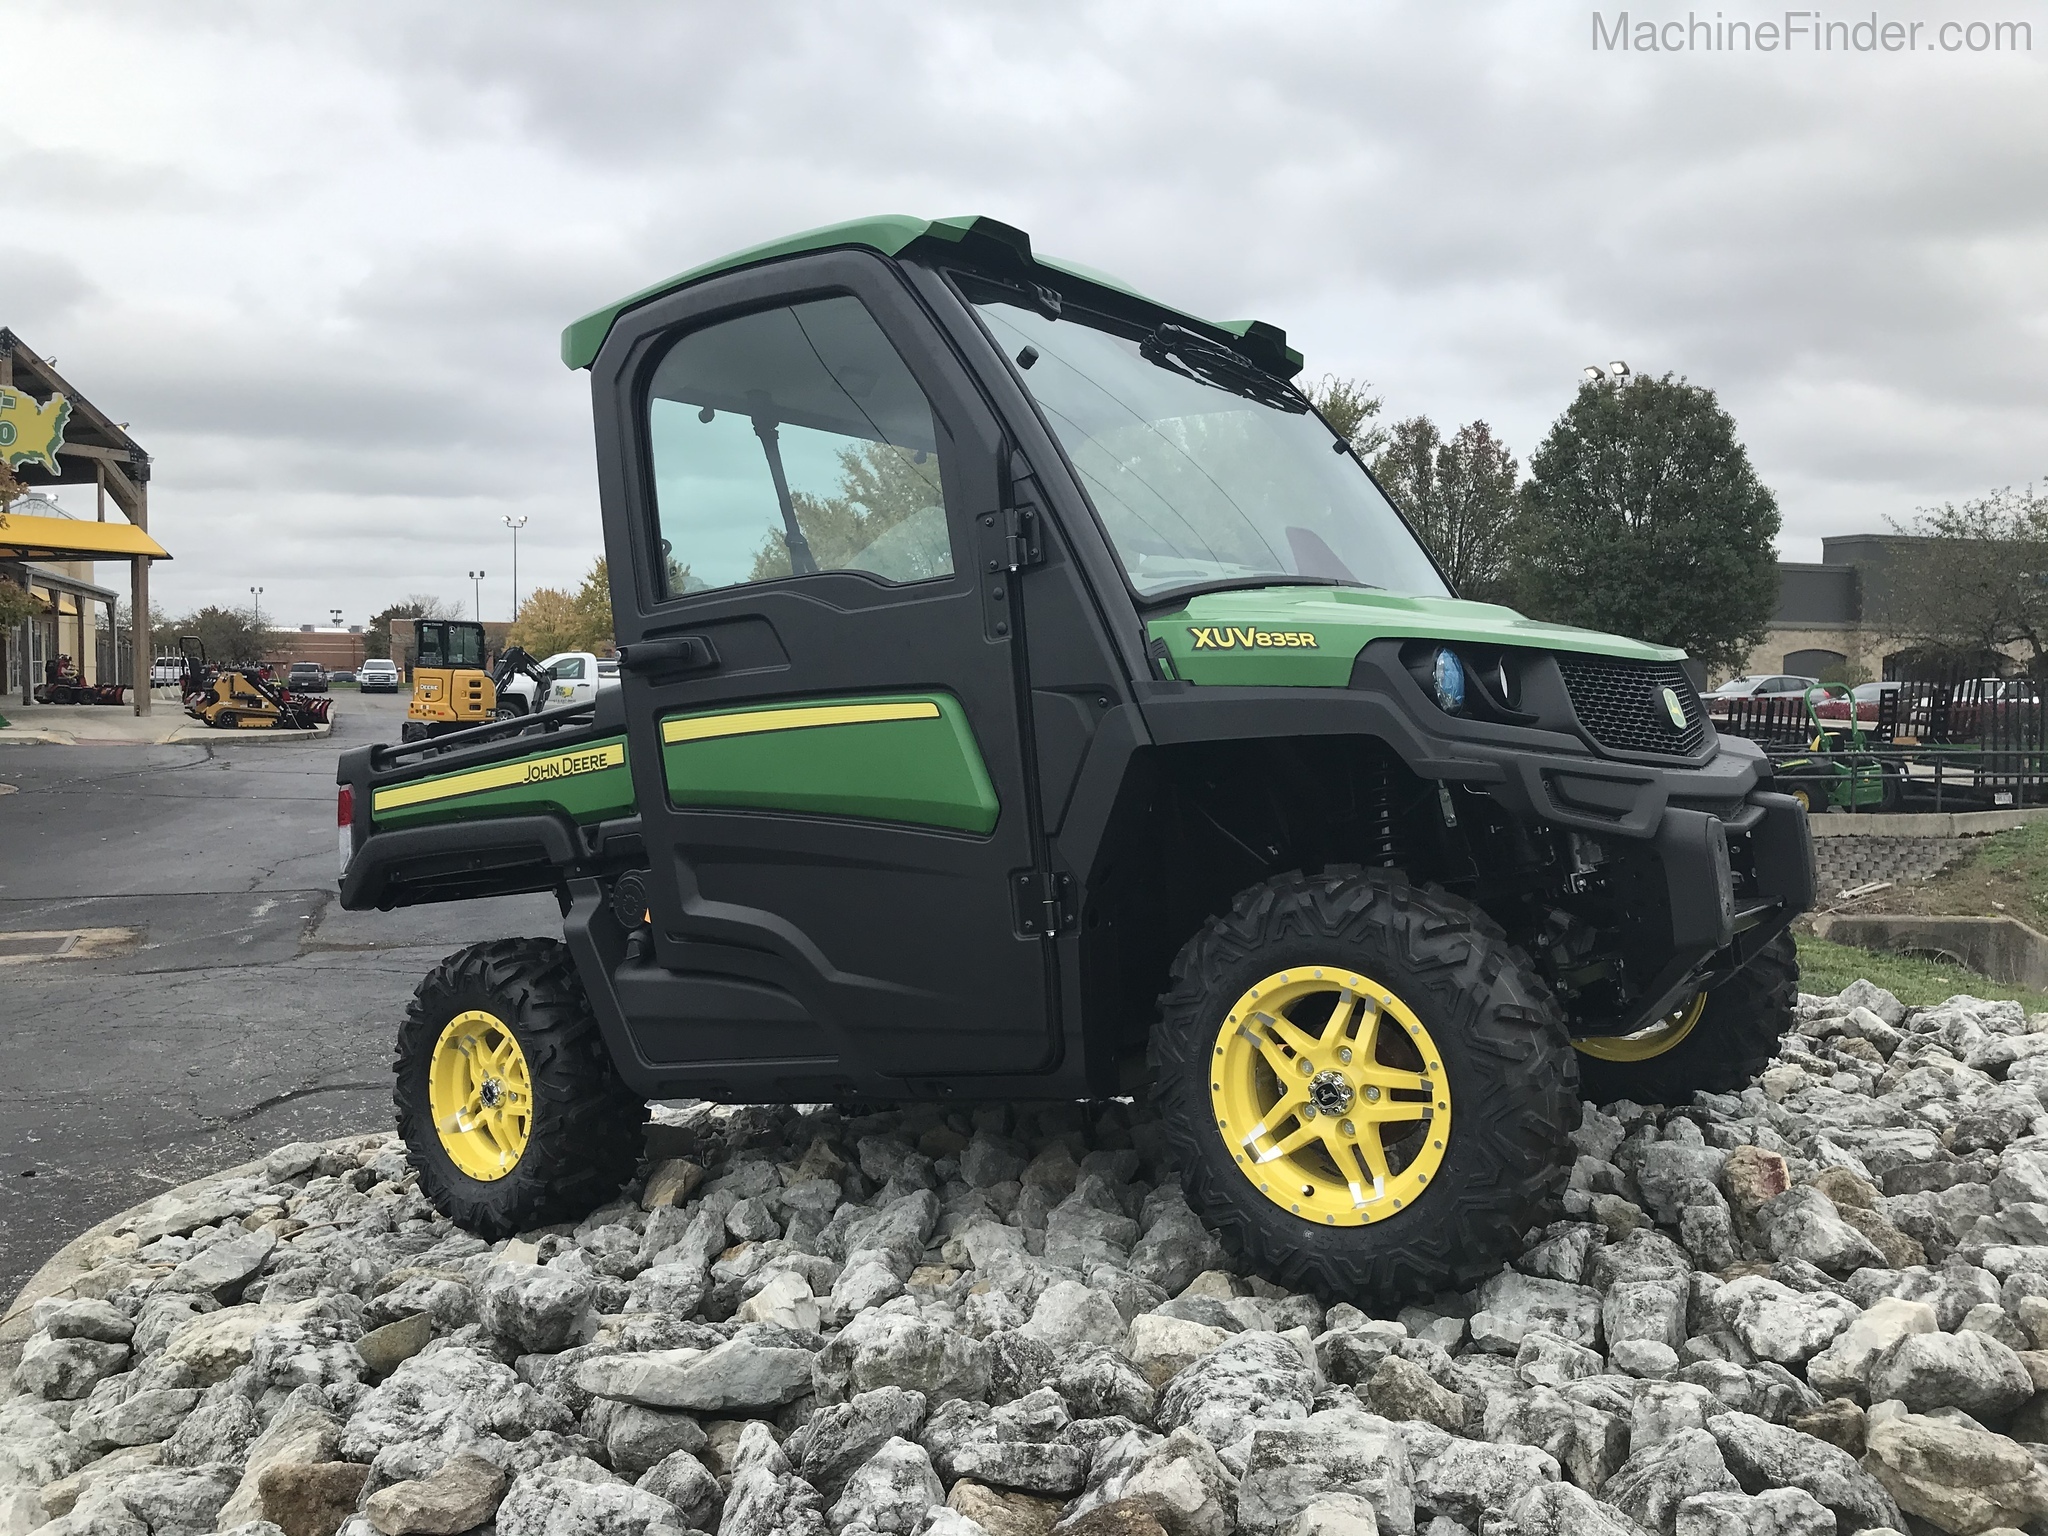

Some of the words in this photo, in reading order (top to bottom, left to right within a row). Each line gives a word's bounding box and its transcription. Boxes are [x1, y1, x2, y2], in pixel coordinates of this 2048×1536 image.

[1189, 627, 1318, 649] XUV835R
[524, 762, 560, 782] JOHN
[562, 753, 608, 774] DEERE
